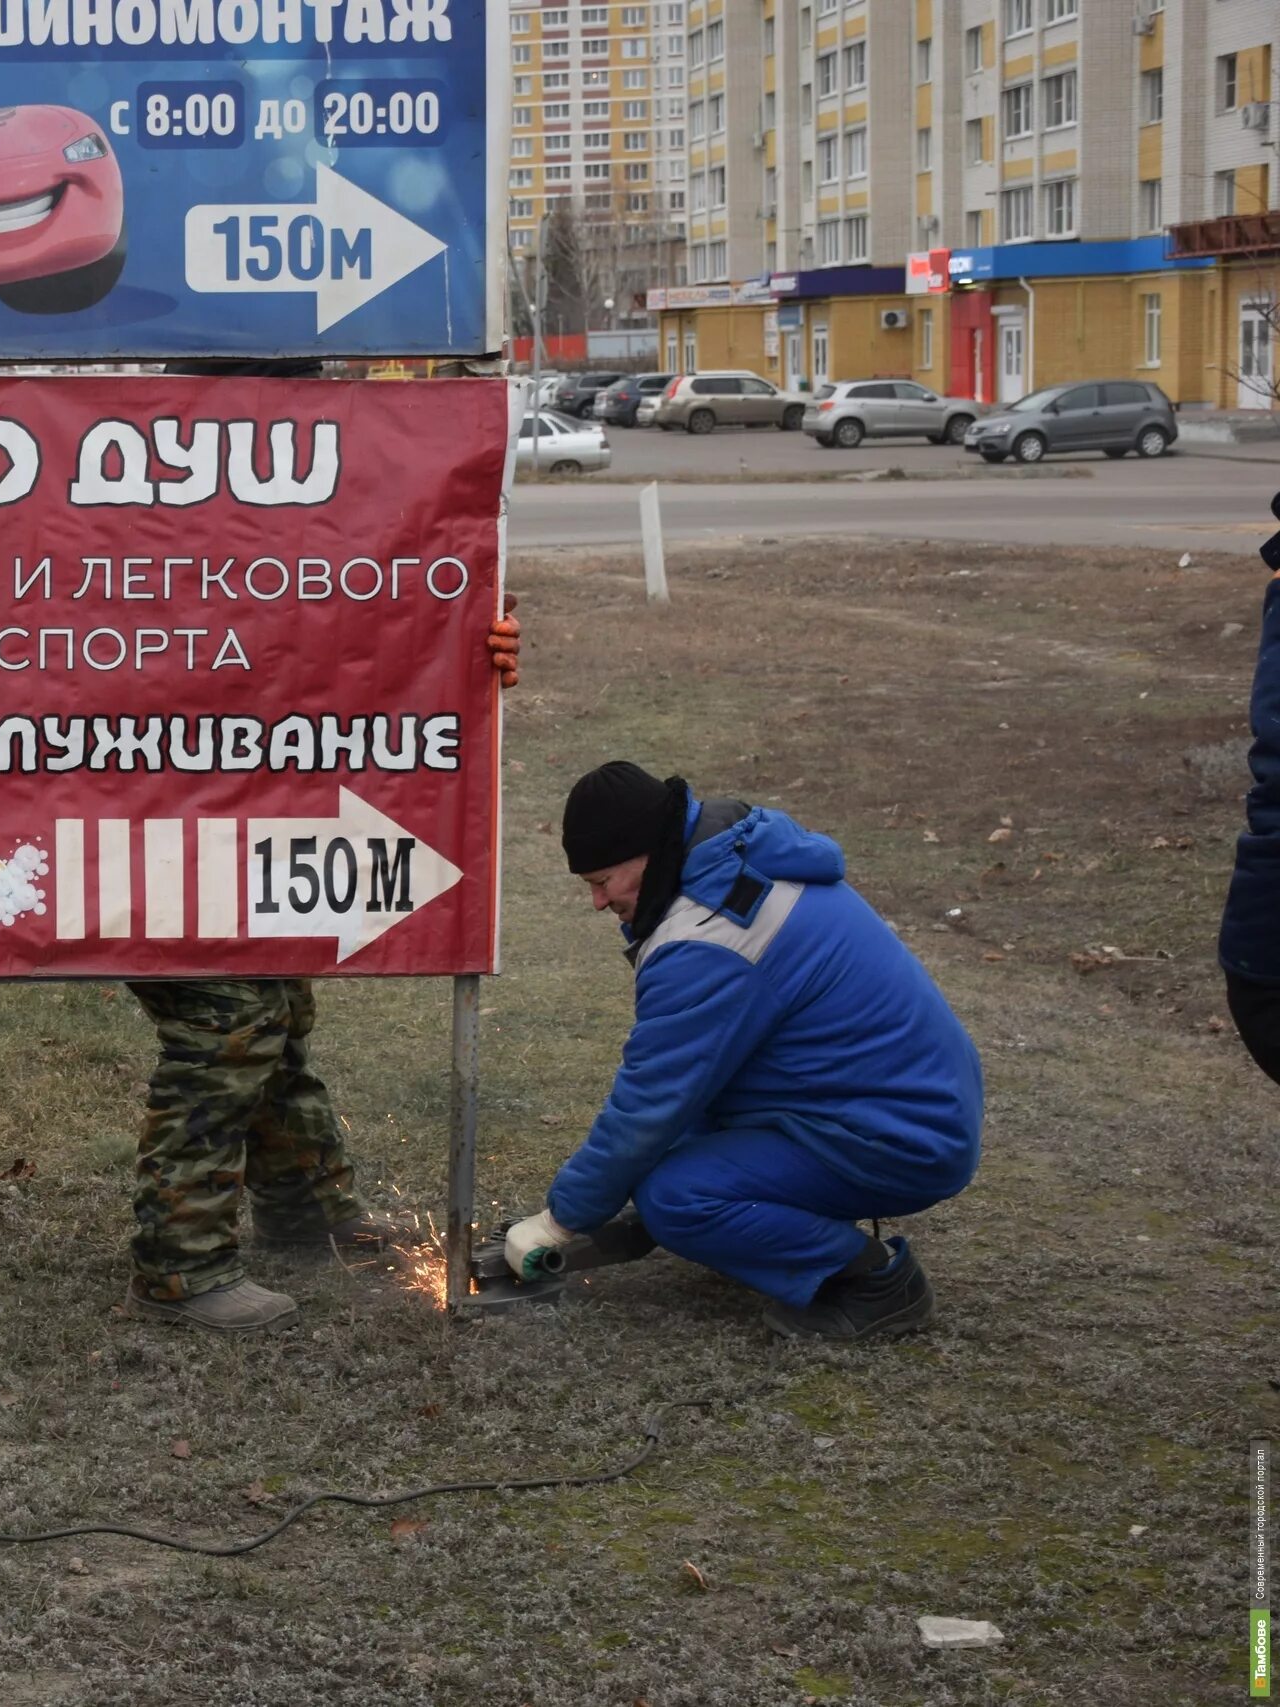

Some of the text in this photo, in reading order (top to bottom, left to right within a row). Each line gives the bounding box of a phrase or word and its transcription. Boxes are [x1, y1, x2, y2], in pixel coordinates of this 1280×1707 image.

[145, 93, 236, 137] 8:00
[255, 99, 306, 140] до
[323, 91, 440, 135] 20:00
[68, 417, 342, 507] ДУШ
[14, 557, 52, 600] И
[73, 556, 469, 601] ЛЕГКОВОГО
